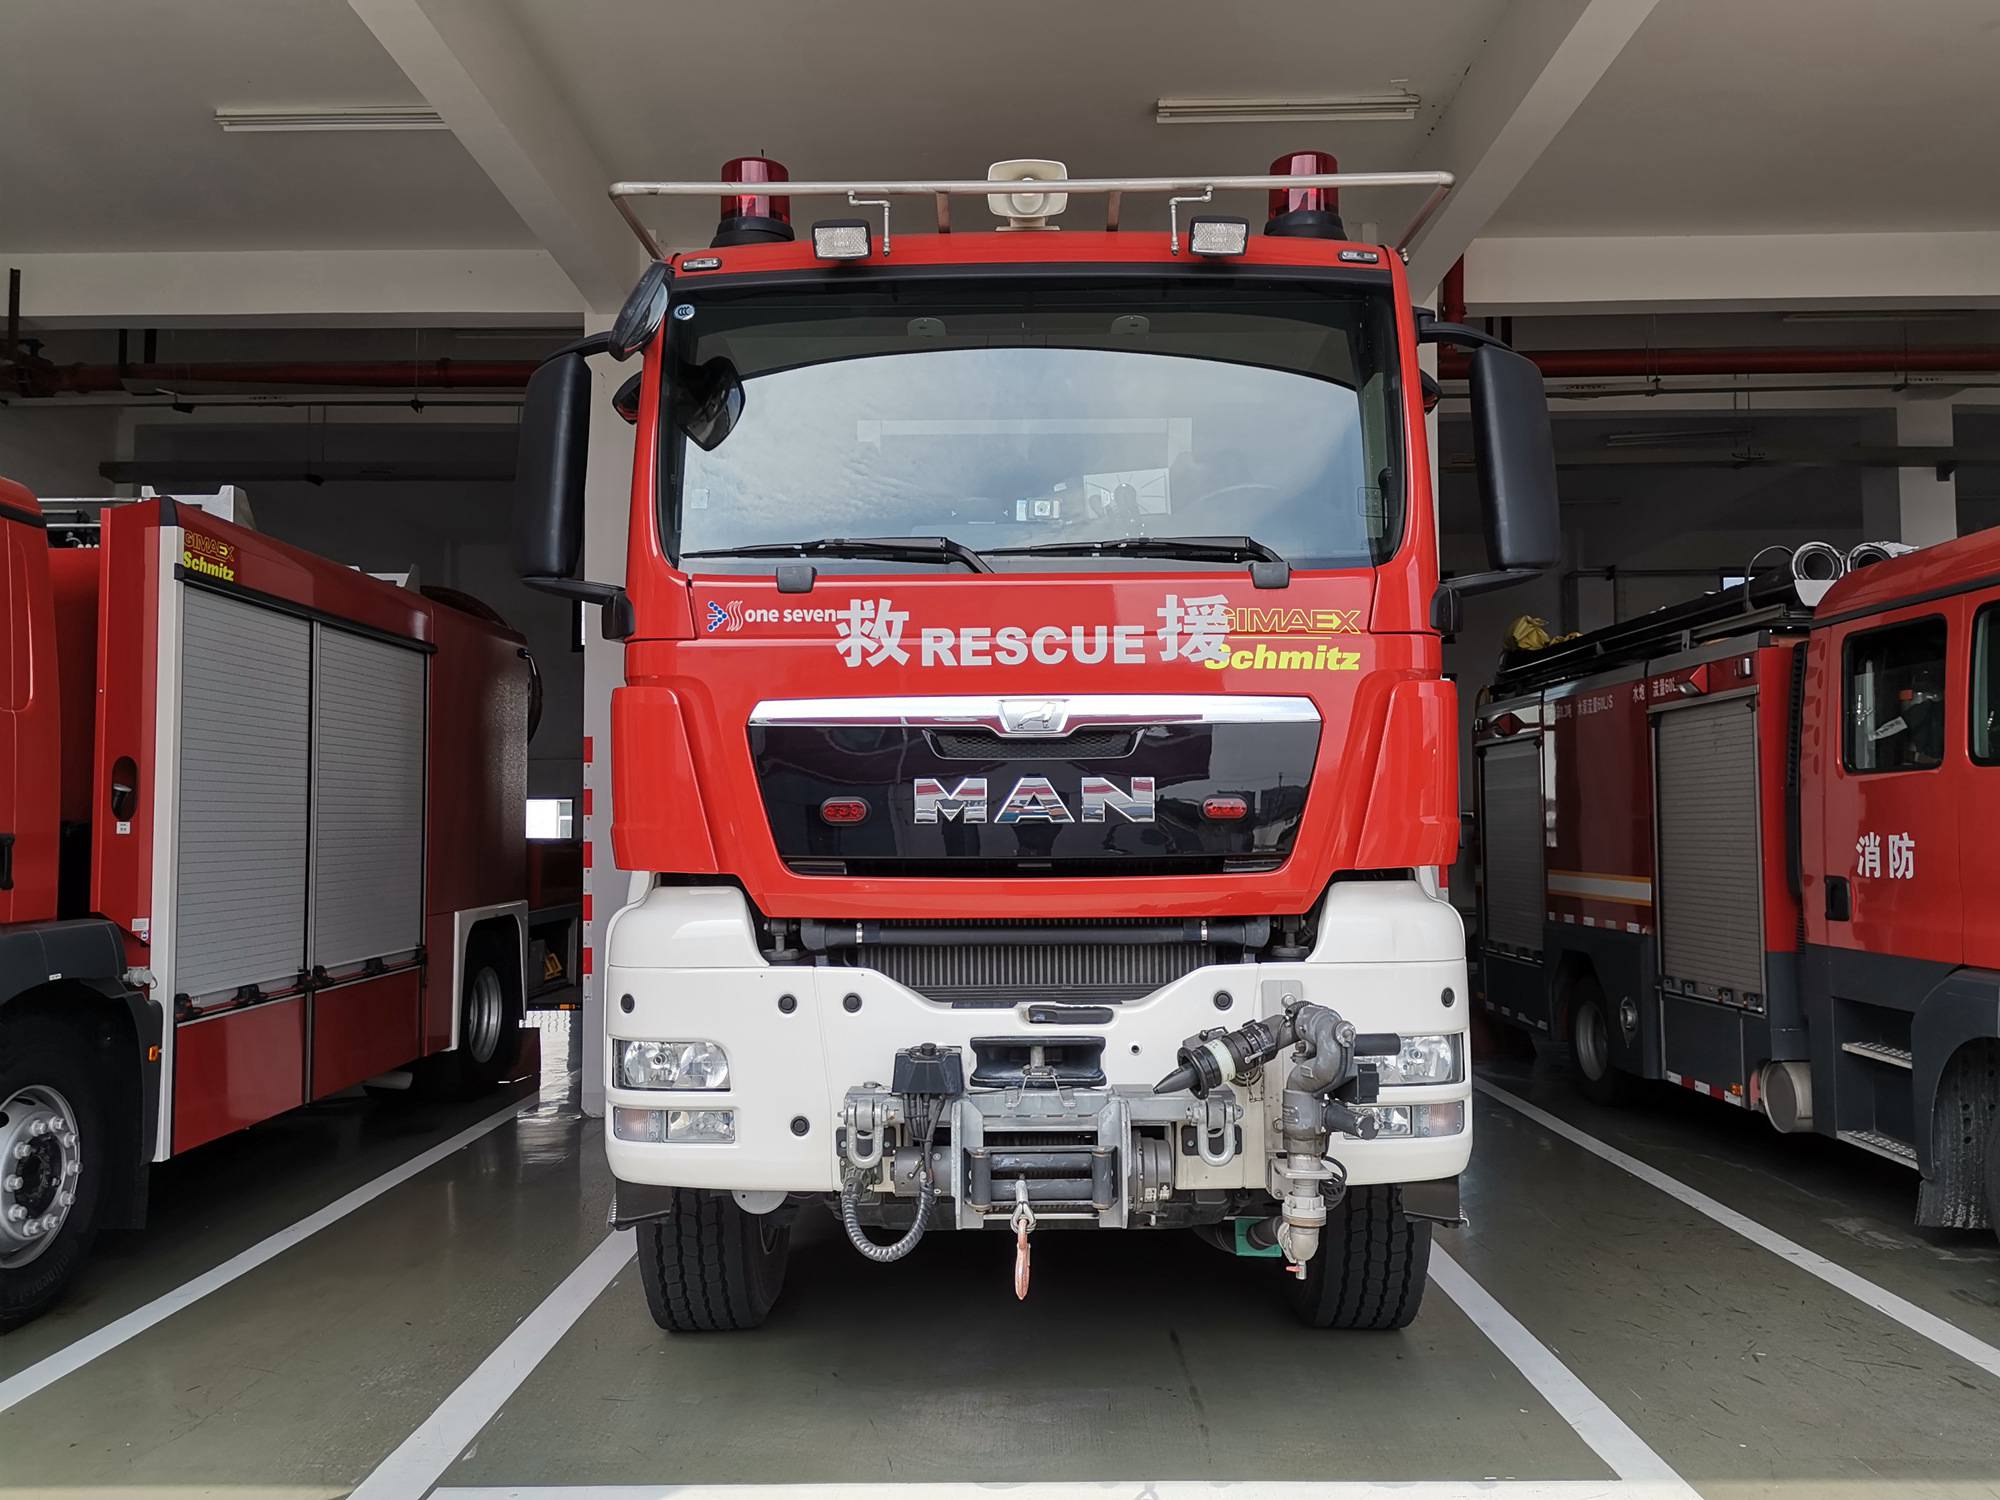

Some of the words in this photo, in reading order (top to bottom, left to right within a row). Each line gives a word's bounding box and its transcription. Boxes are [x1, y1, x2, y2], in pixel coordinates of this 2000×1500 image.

[183, 551, 234, 582] Schmitz
[744, 608, 779, 623] one
[783, 608, 837, 623] seven
[835, 598, 910, 668] 救
[921, 626, 1146, 667] RESCUE
[1157, 594, 1230, 663] 援
[1204, 644, 1360, 671] Schmitz
[914, 776, 1156, 824] MAN
[1855, 831, 1915, 880] 消防
